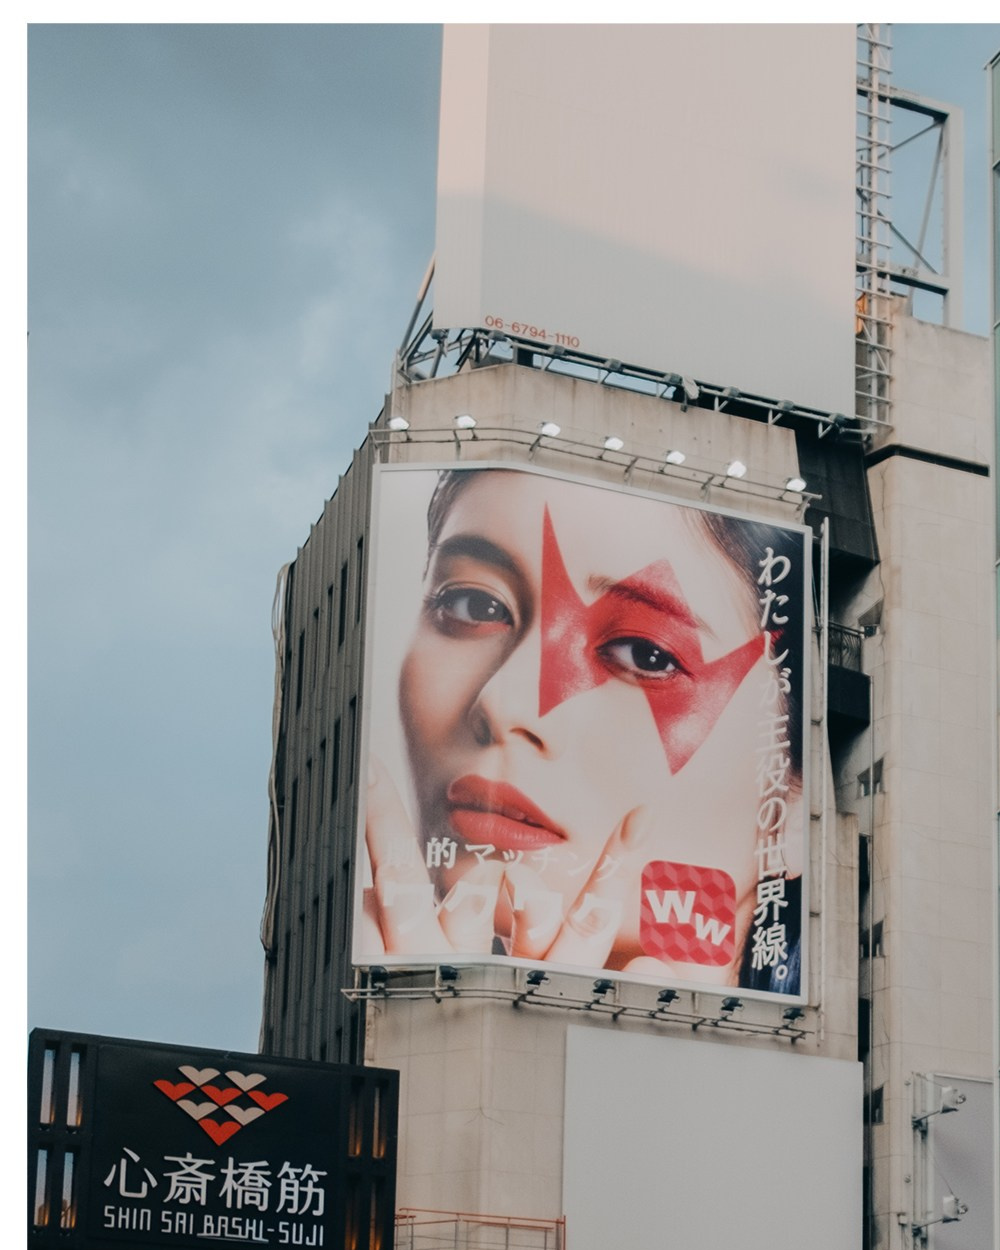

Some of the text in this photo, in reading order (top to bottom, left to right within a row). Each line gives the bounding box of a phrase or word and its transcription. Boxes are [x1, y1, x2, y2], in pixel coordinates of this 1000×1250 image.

[485, 315, 580, 348] 06-6794-1110
[103, 1147, 328, 1216] 心斎橋筋
[104, 1205, 151, 1231] SHIN
[161, 1210, 194, 1235] SAI
